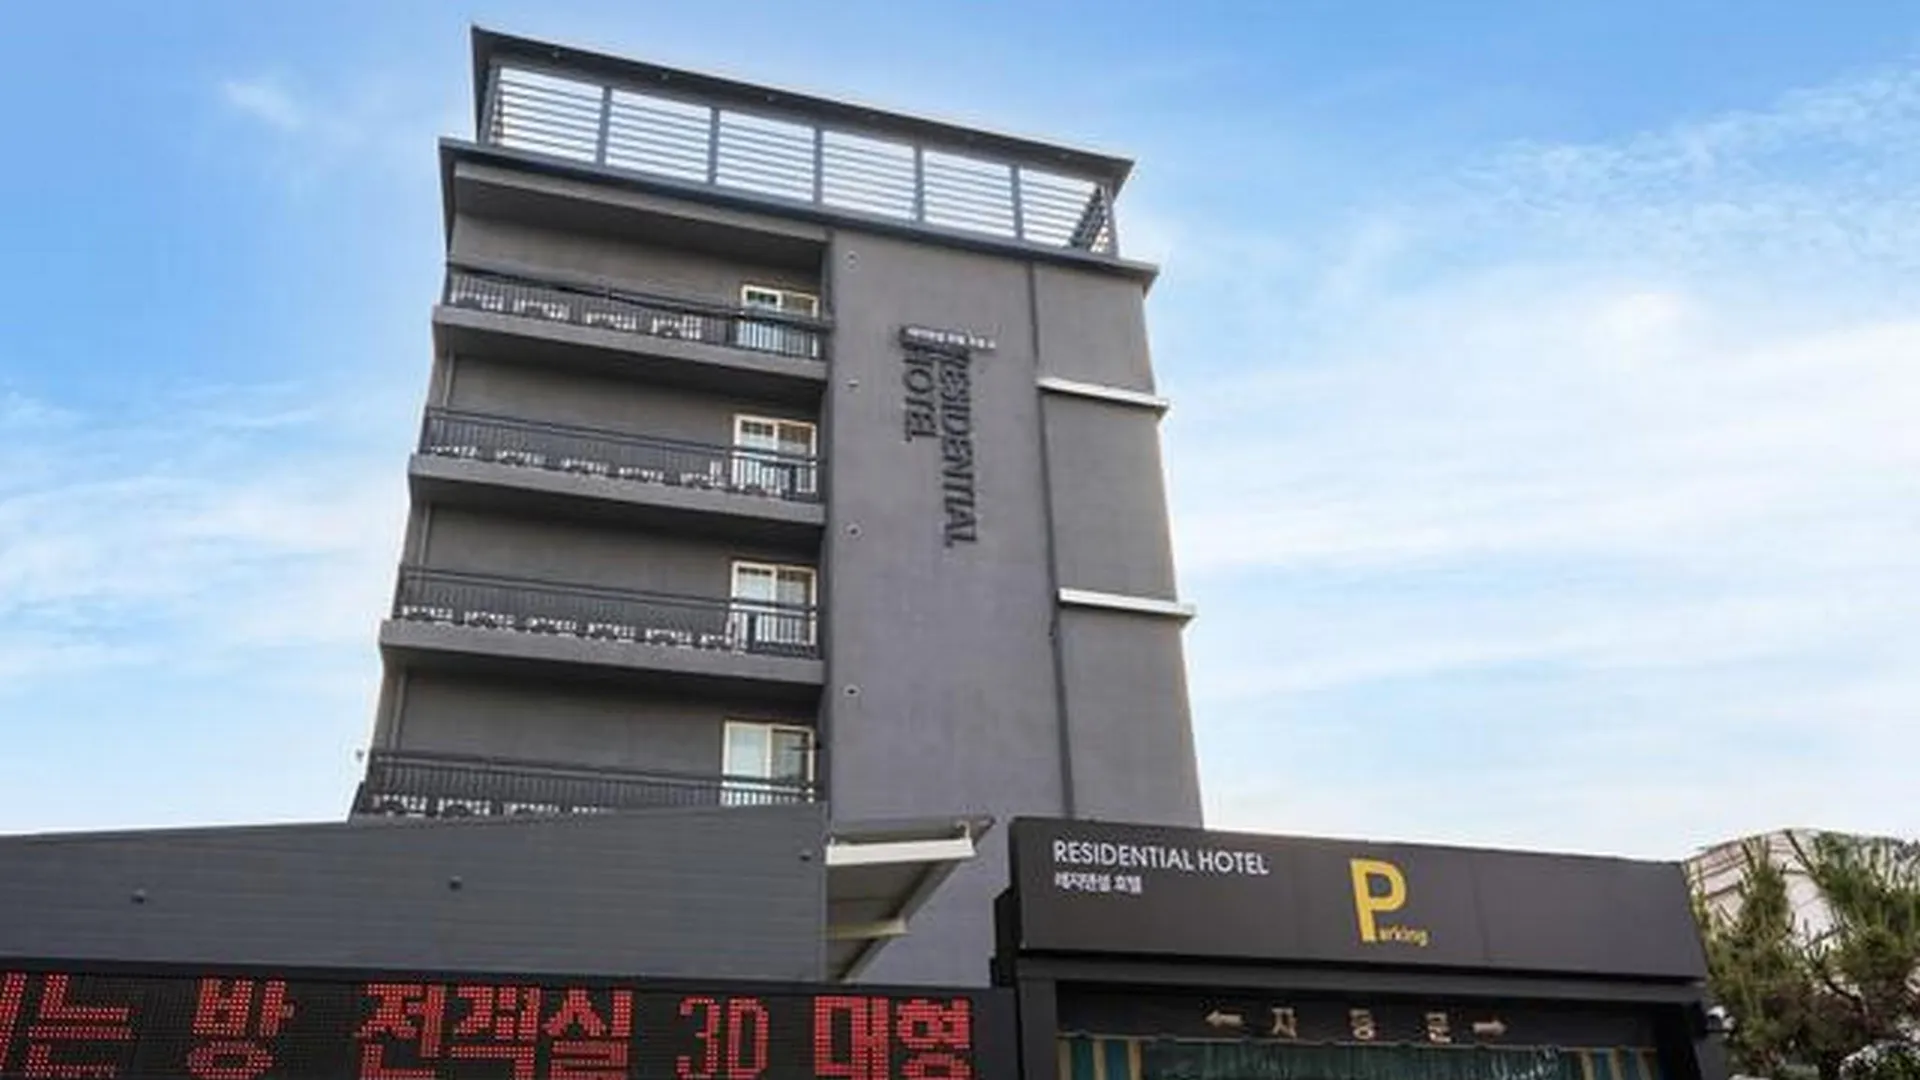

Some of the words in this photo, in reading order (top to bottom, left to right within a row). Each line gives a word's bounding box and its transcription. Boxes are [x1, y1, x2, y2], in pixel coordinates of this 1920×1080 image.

[1053, 840, 1194, 871] RESIDENTIAL
[1199, 851, 1270, 875] HOTEL
[188, 979, 294, 1080] 방
[677, 996, 769, 1080] 3D
[815, 996, 972, 1080] 대형
